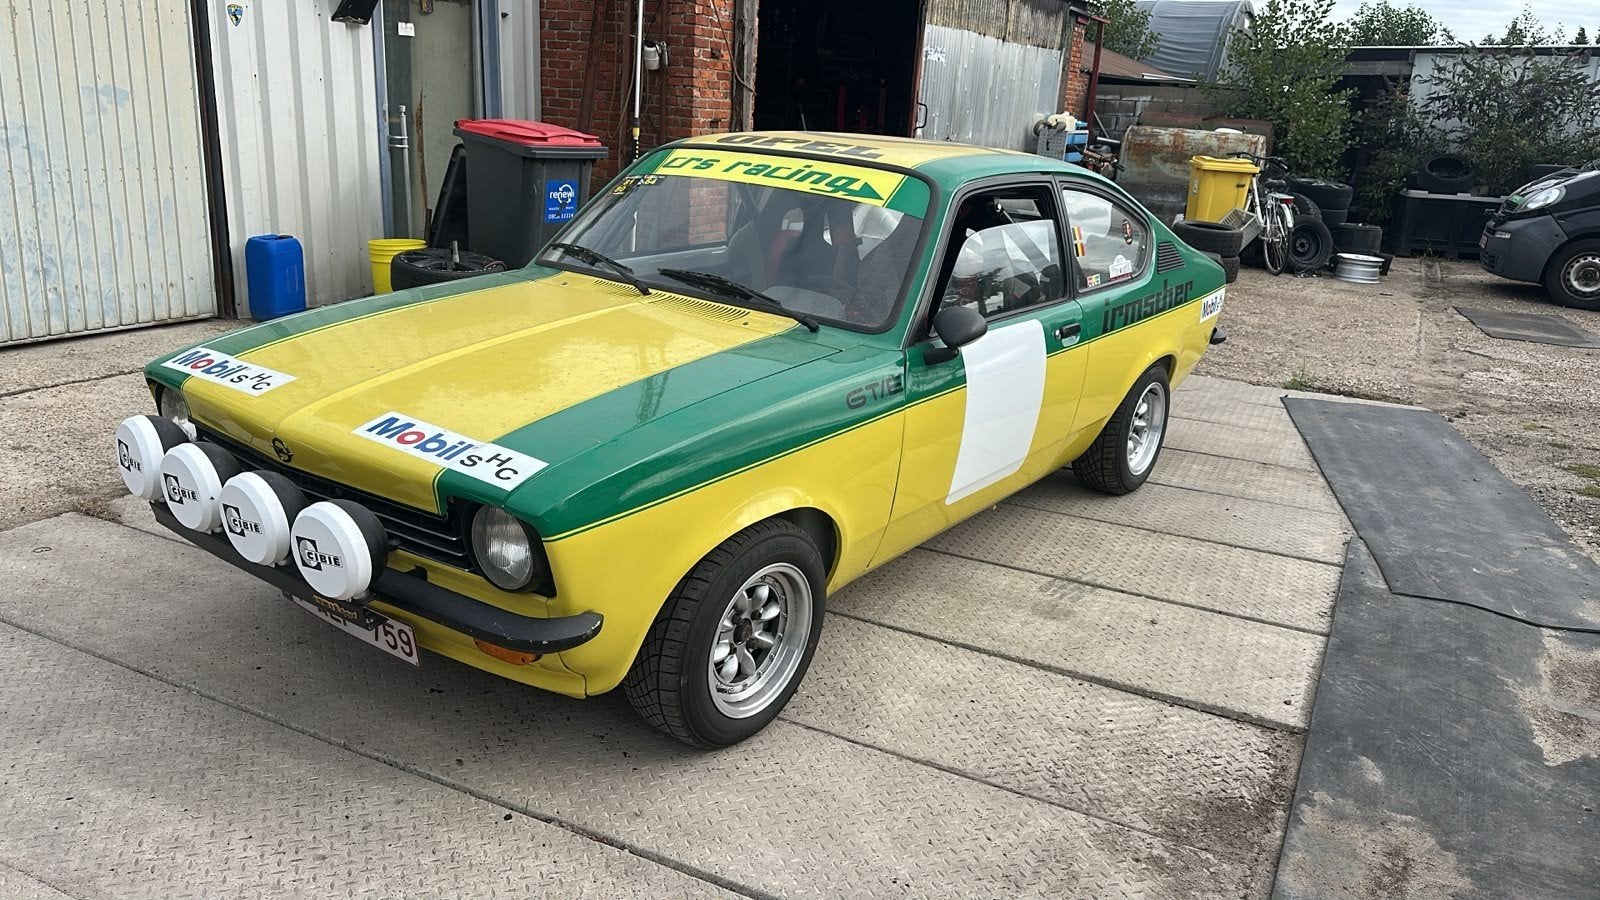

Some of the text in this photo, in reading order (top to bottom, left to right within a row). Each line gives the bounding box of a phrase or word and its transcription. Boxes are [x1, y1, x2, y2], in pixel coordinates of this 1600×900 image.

[717, 135, 885, 159] OPEL
[722, 165, 861, 194] racing
[1102, 279, 1193, 334] irmscher
[172, 350, 248, 379] Mobil
[845, 374, 904, 410] GT/E
[366, 416, 475, 461] Mobil
[172, 487, 198, 500] CIBIE
[231, 517, 261, 533] CIBIE
[306, 550, 341, 567] CIBIE
